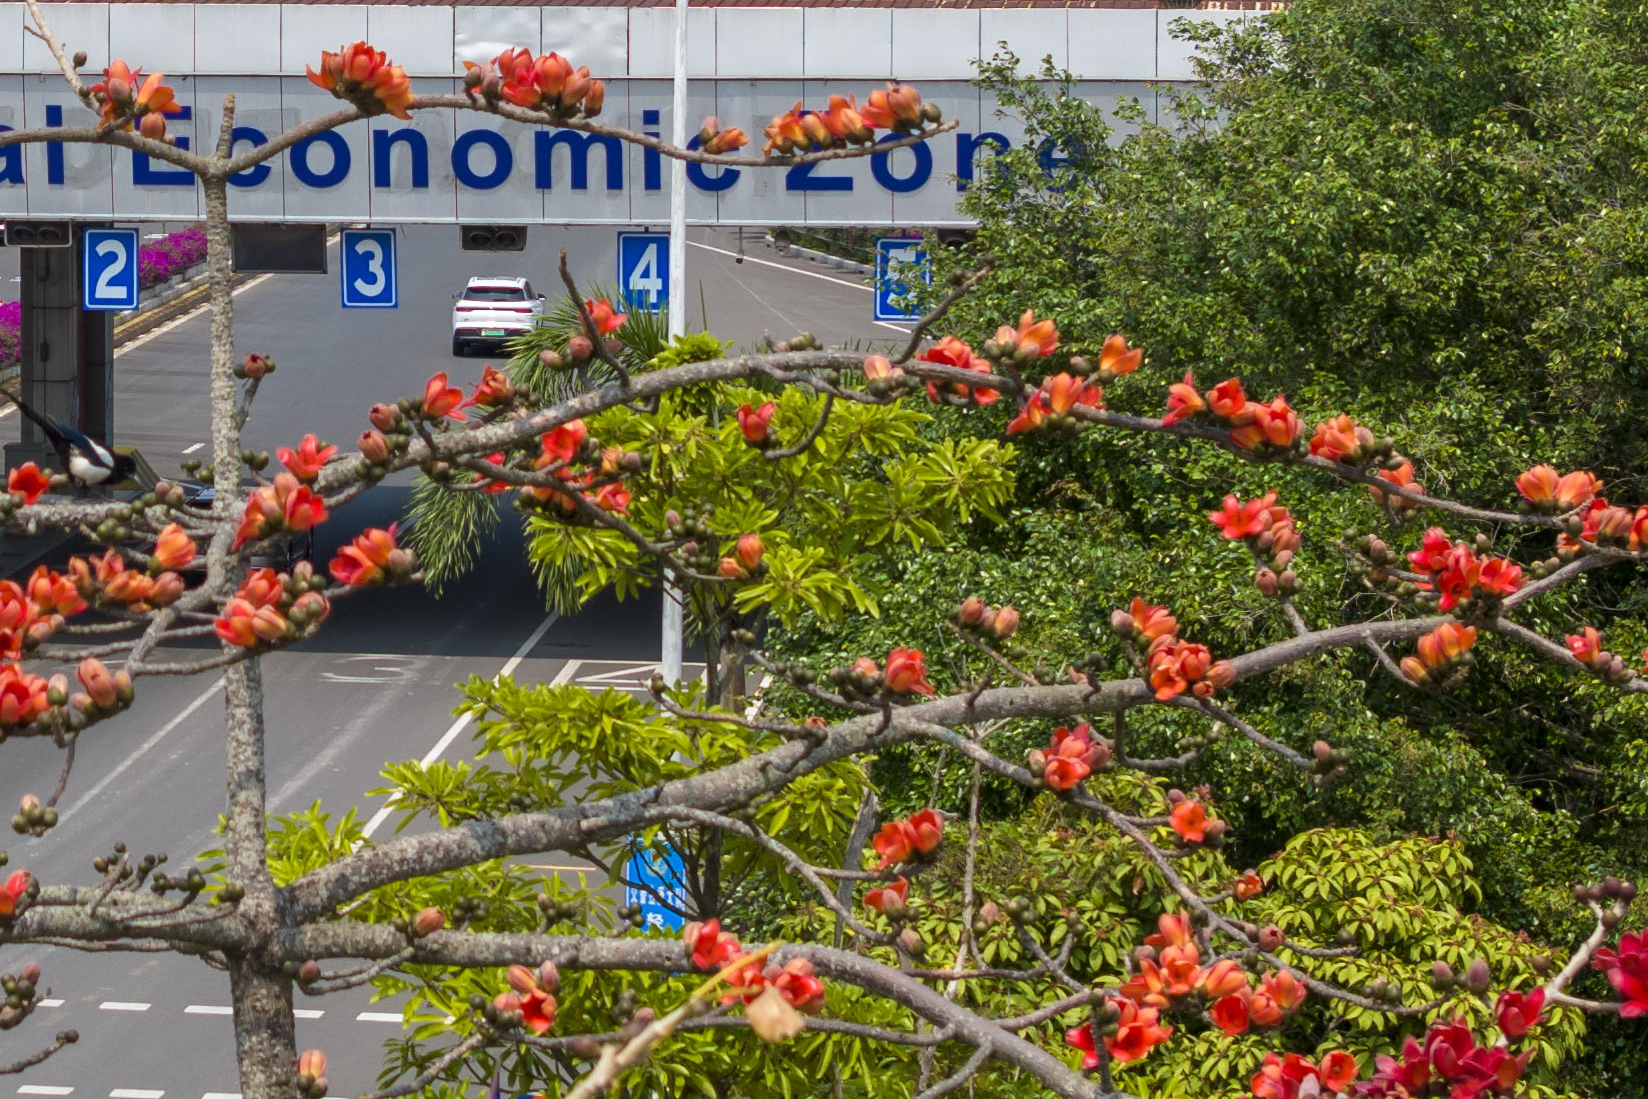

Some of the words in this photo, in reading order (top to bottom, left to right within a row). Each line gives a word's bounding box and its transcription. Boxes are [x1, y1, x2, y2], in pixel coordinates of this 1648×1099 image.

[95, 239, 128, 299] 2
[353, 239, 386, 297] 3
[629, 243, 663, 304] 4
